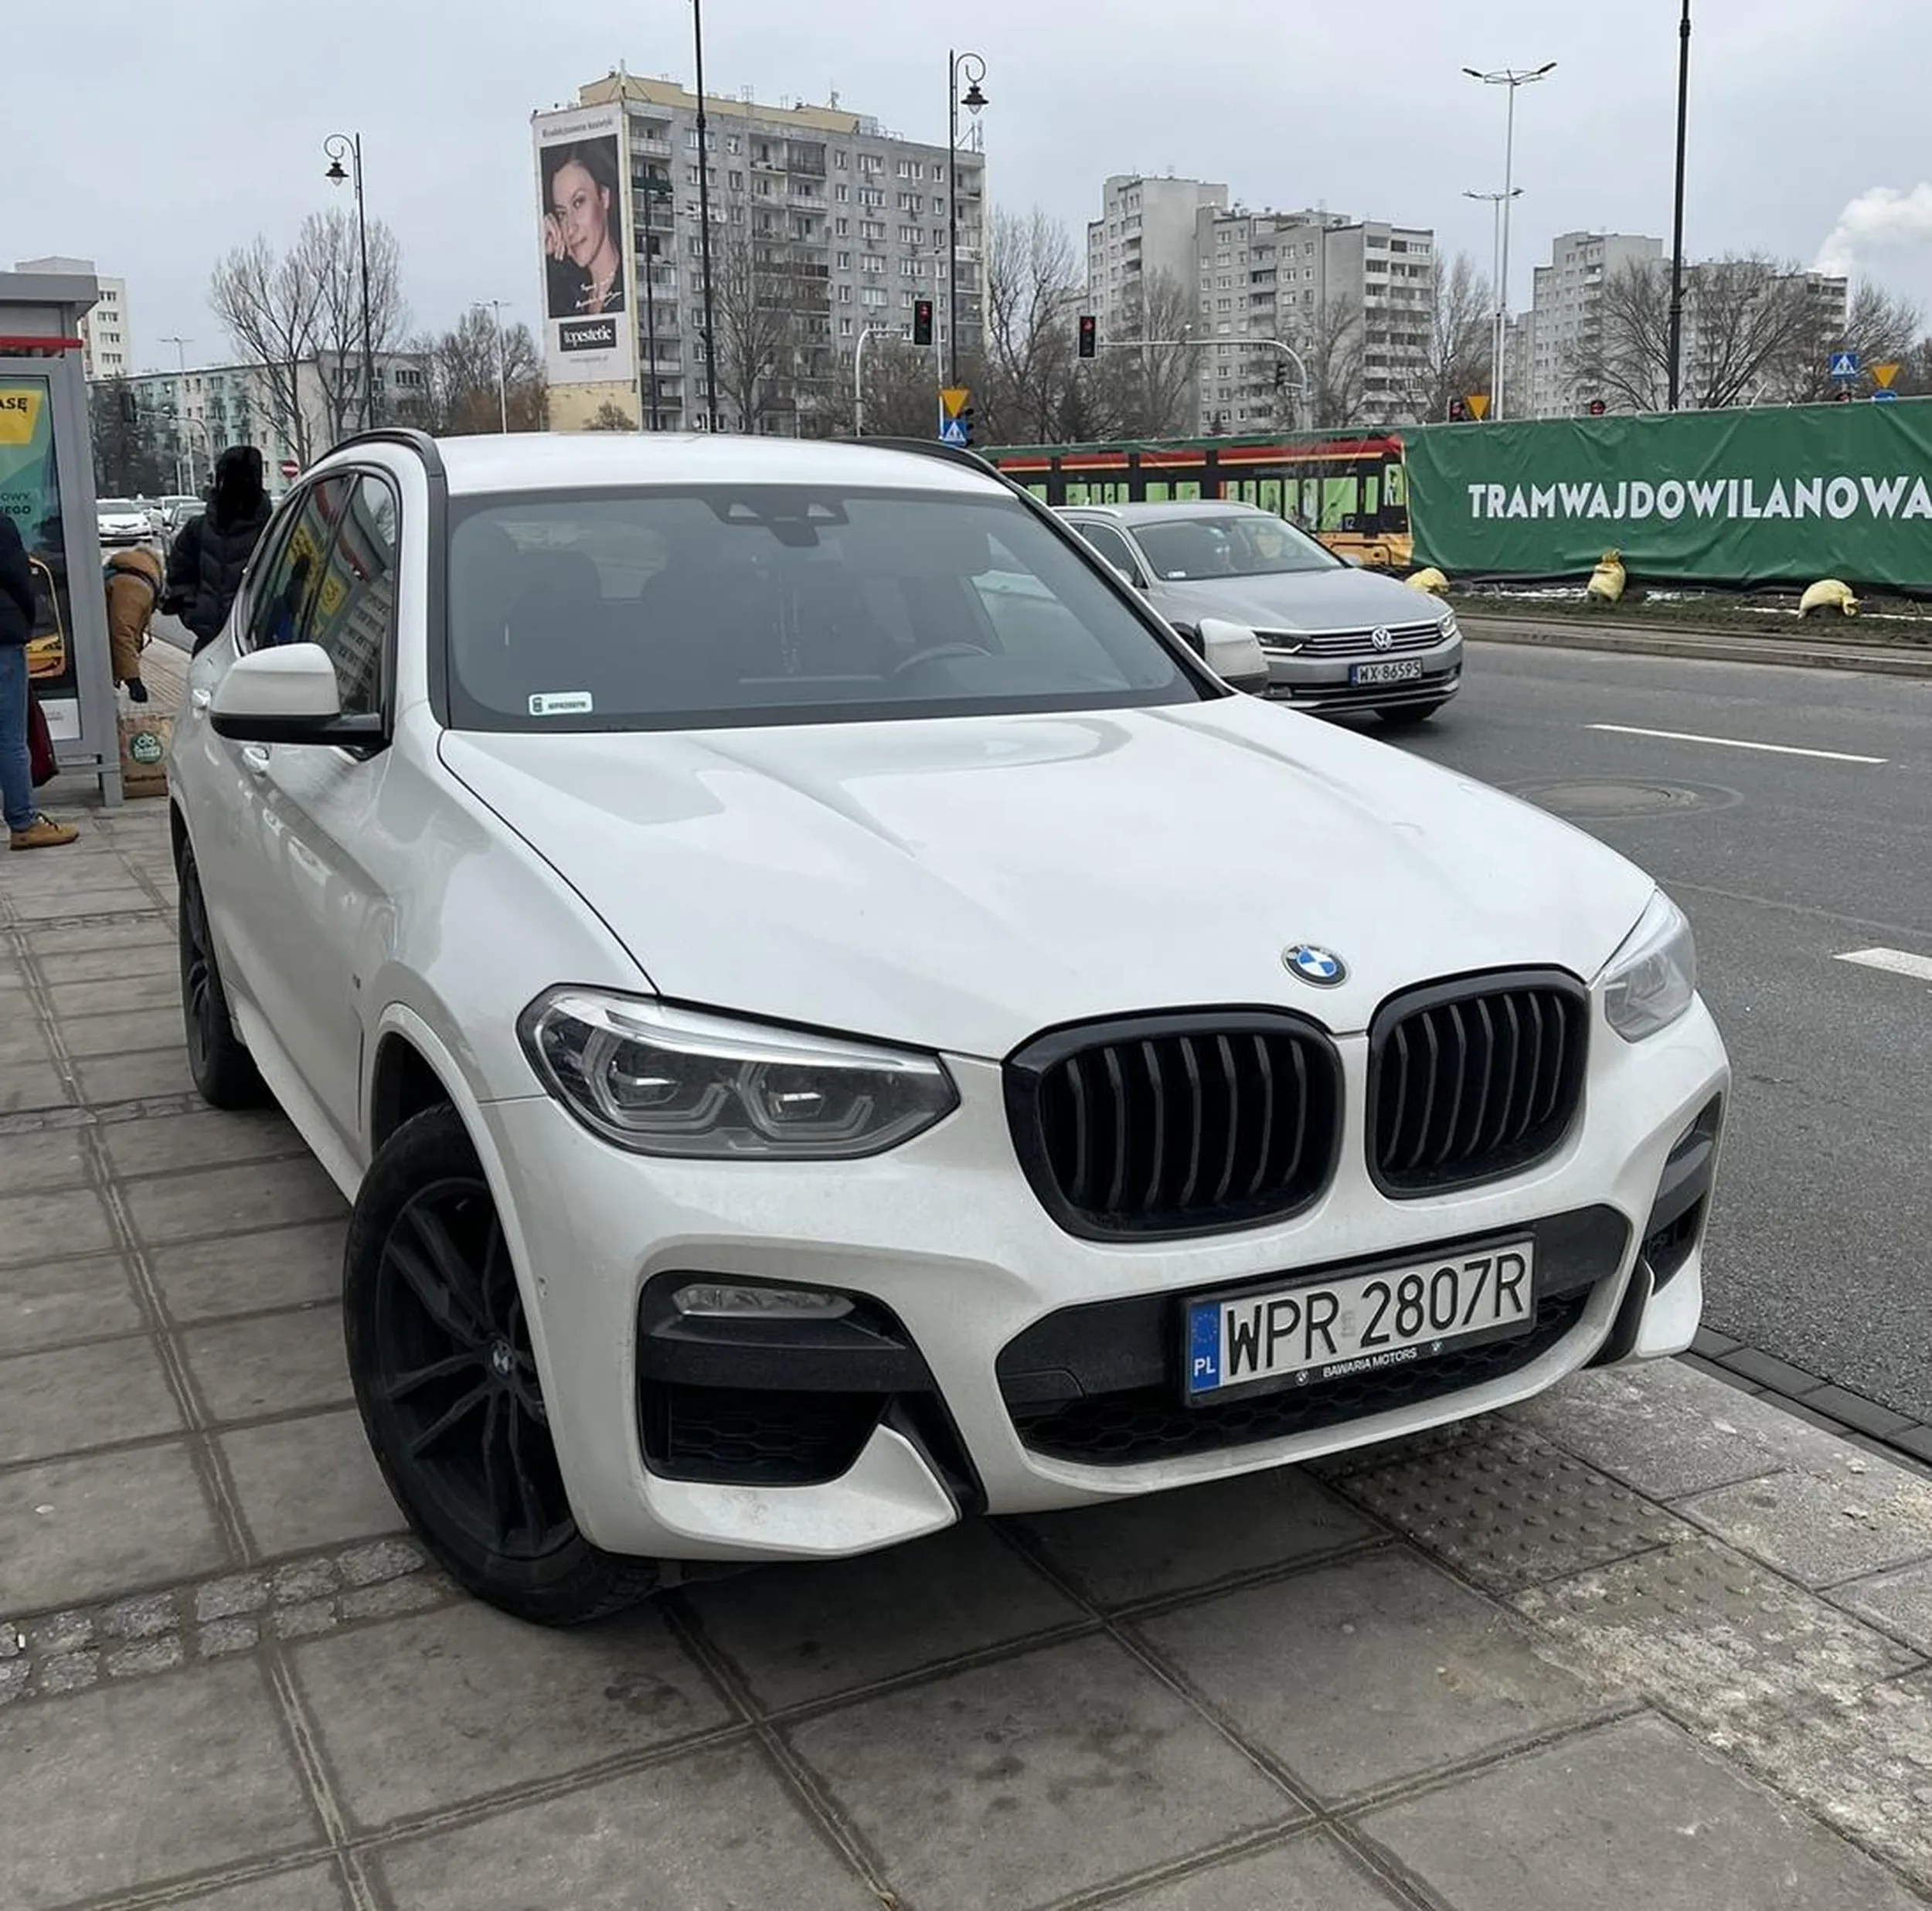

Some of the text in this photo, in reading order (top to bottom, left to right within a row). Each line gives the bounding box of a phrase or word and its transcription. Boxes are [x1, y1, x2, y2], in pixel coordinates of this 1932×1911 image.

[1468, 476, 1932, 520] TRAMWAJDOWILANOWA
[1360, 666, 1378, 681] WX
[1382, 661, 1420, 679] 86595
[1227, 1253, 1527, 1376] WPR 2807R
[1194, 1356, 1216, 1376] PL
[1322, 1348, 1417, 1378] BAWARIA MOTORS
